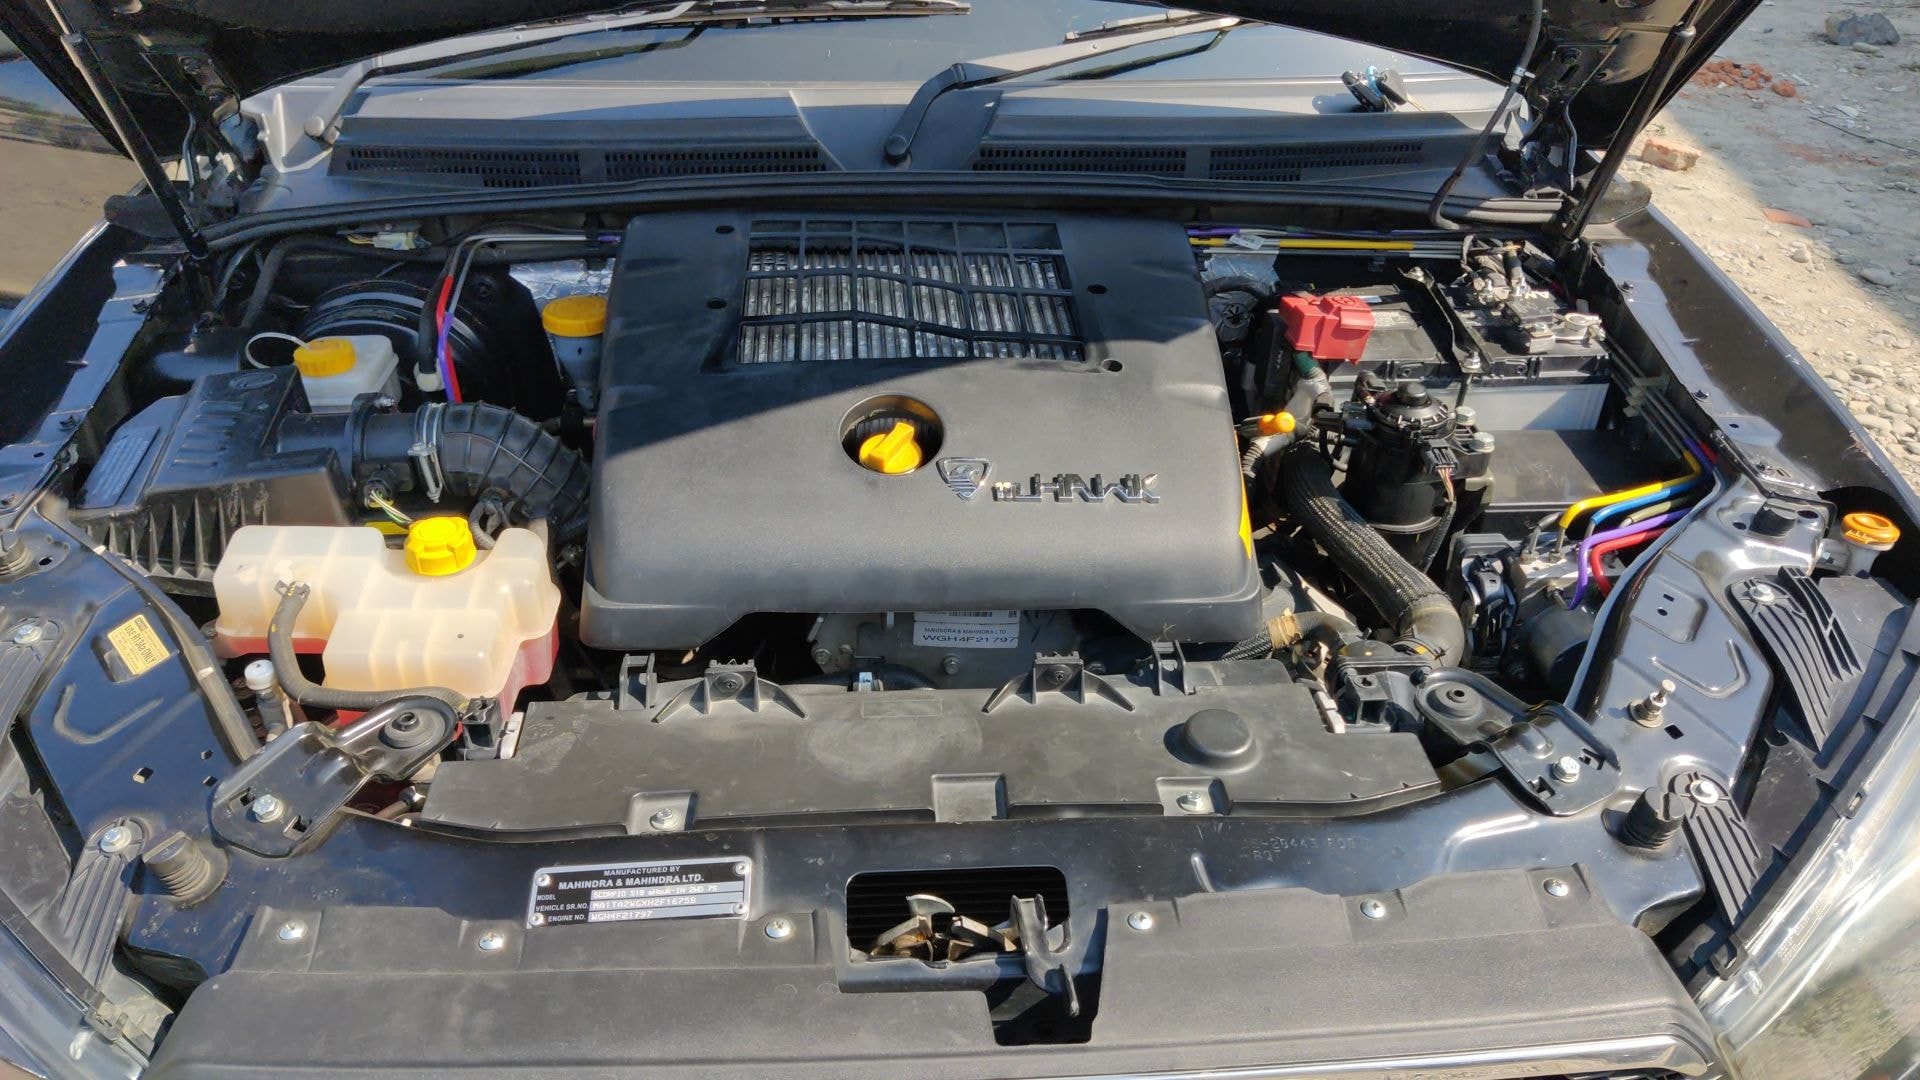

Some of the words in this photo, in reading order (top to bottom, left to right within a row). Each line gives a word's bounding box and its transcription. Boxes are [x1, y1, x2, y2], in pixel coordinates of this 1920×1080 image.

[923, 634, 1017, 644] WGH4F21797
[141, 648, 158, 665] ONLY
[603, 865, 668, 877] MANUFACTURED
[669, 865, 681, 873] BY
[558, 879, 614, 890] MAHINDRA
[615, 878, 623, 887] &
[625, 875, 681, 887] MAHINDRA
[682, 873, 705, 884] LTD.
[536, 893, 556, 901] MODEL
[593, 890, 627, 899] SCORPIO
[535, 903, 565, 912] VEHICLE
[547, 914, 573, 923] ENGINE
